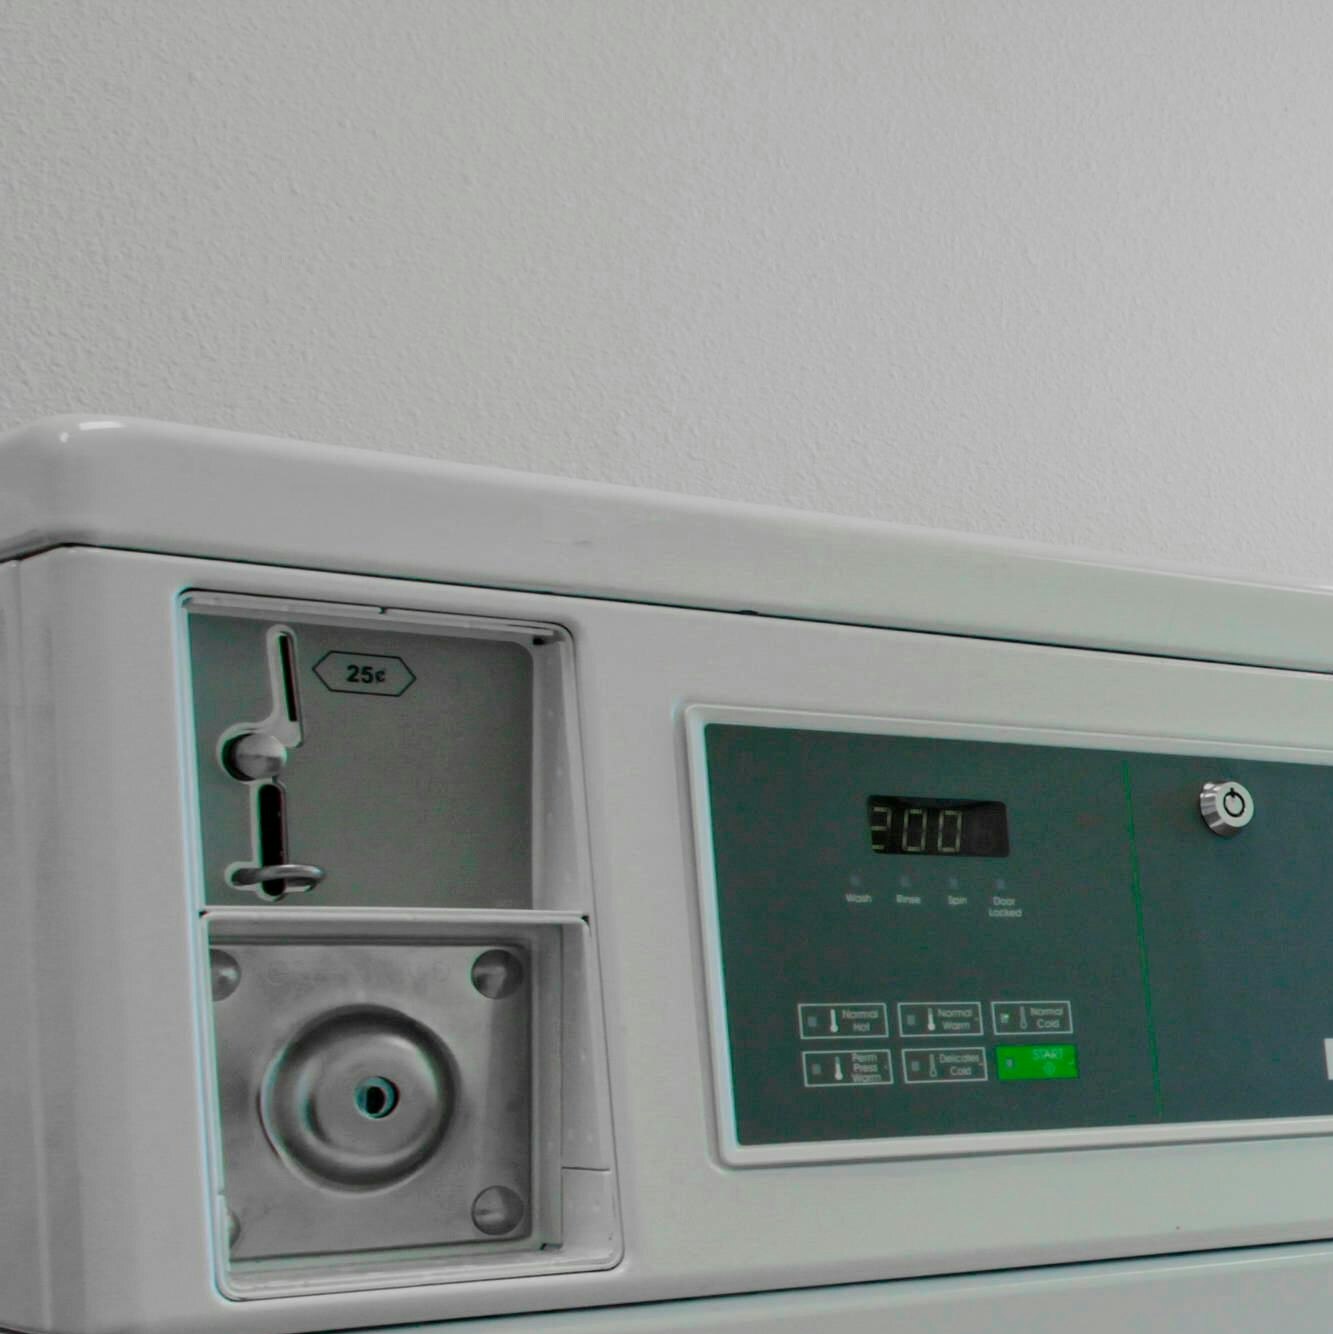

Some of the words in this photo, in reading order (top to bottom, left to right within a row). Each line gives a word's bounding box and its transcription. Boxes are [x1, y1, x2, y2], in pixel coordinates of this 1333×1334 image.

[346, 664, 386, 685] 25¢
[842, 1009, 879, 1019] Normal
[938, 1009, 973, 1018] Normal
[1030, 1007, 1063, 1016] Normal
[942, 1021, 971, 1030] Warm
[1036, 1019, 1060, 1028] Cold
